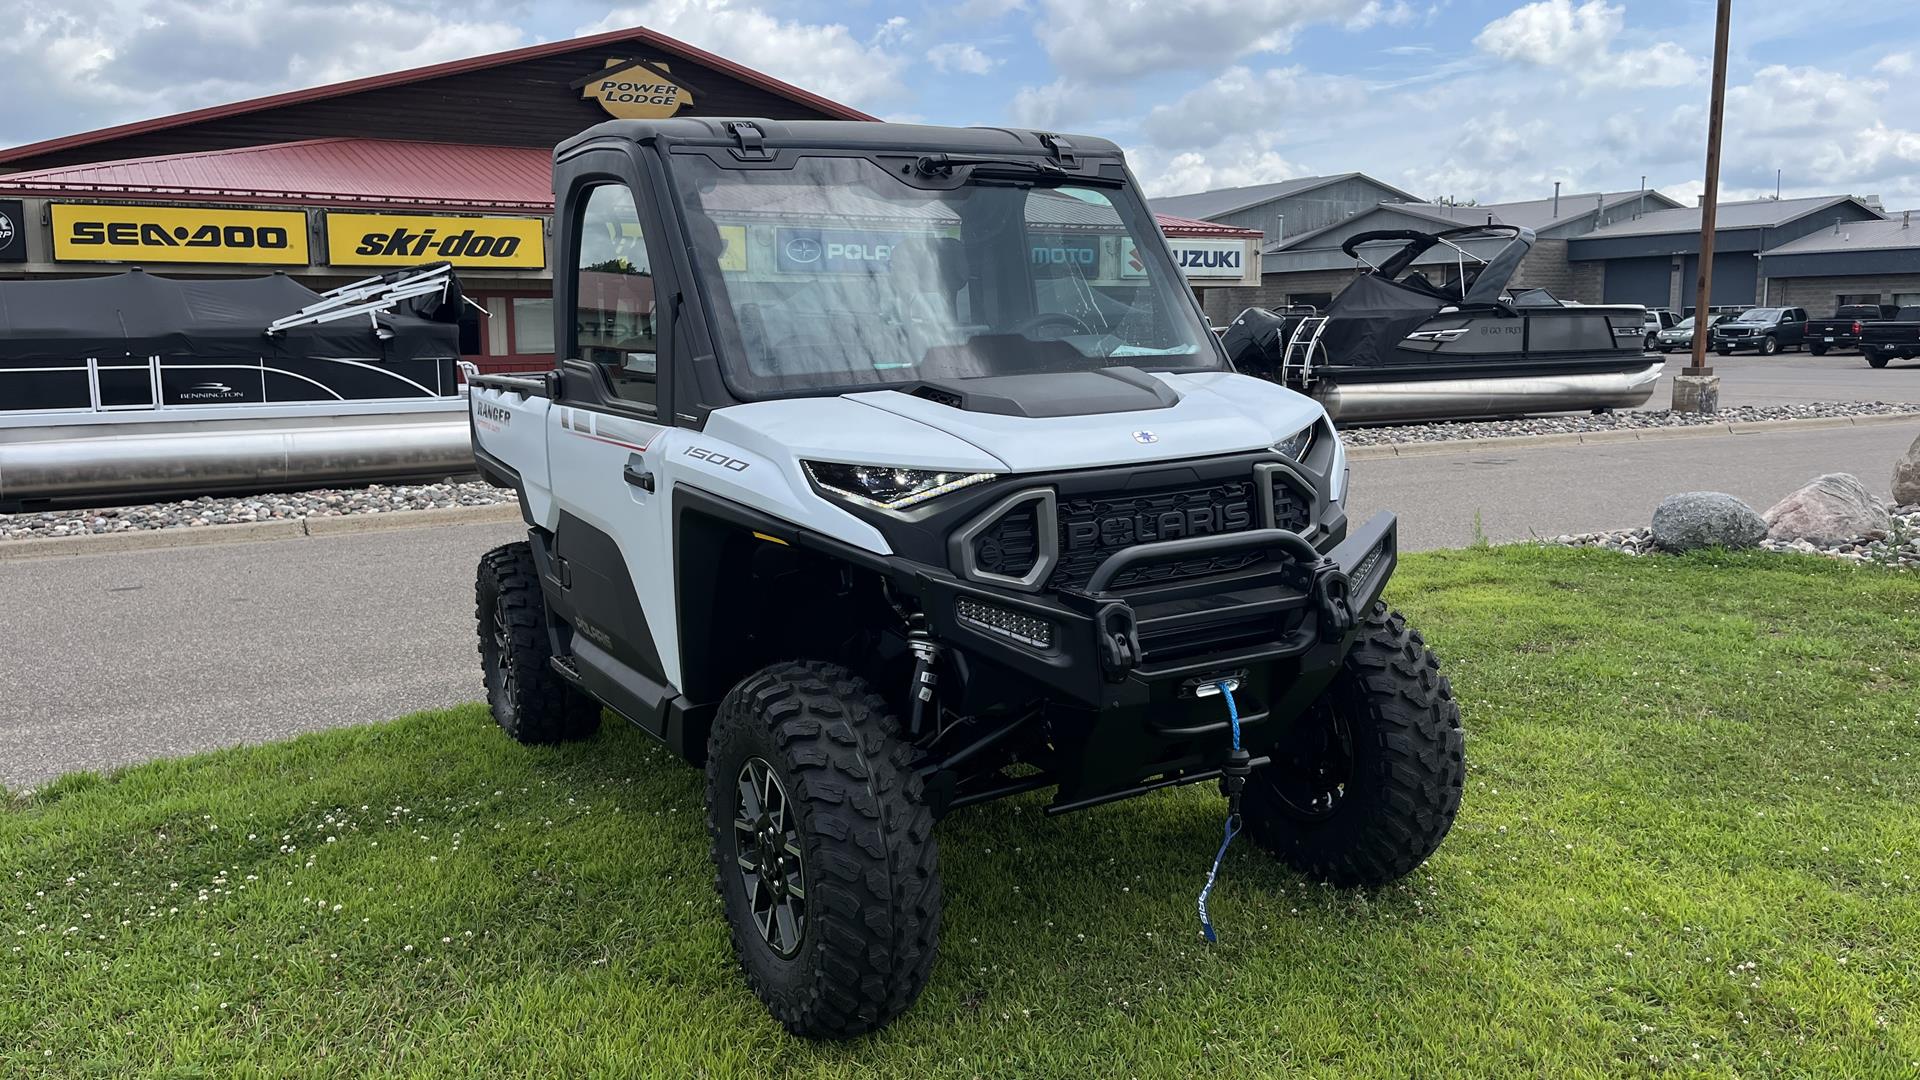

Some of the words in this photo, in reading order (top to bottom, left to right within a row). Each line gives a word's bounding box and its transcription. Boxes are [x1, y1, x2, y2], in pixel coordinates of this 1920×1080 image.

[600, 81, 679, 95] POWER
[605, 91, 676, 106] LODGE
[355, 228, 521, 258] ski-doo
[827, 243, 896, 261] POLA
[1172, 250, 1240, 268] UZUKI
[180, 391, 244, 399] BENNINGTON
[477, 400, 512, 427] RANGER
[682, 446, 750, 472] 1500
[1067, 501, 1251, 550] POLARIS
